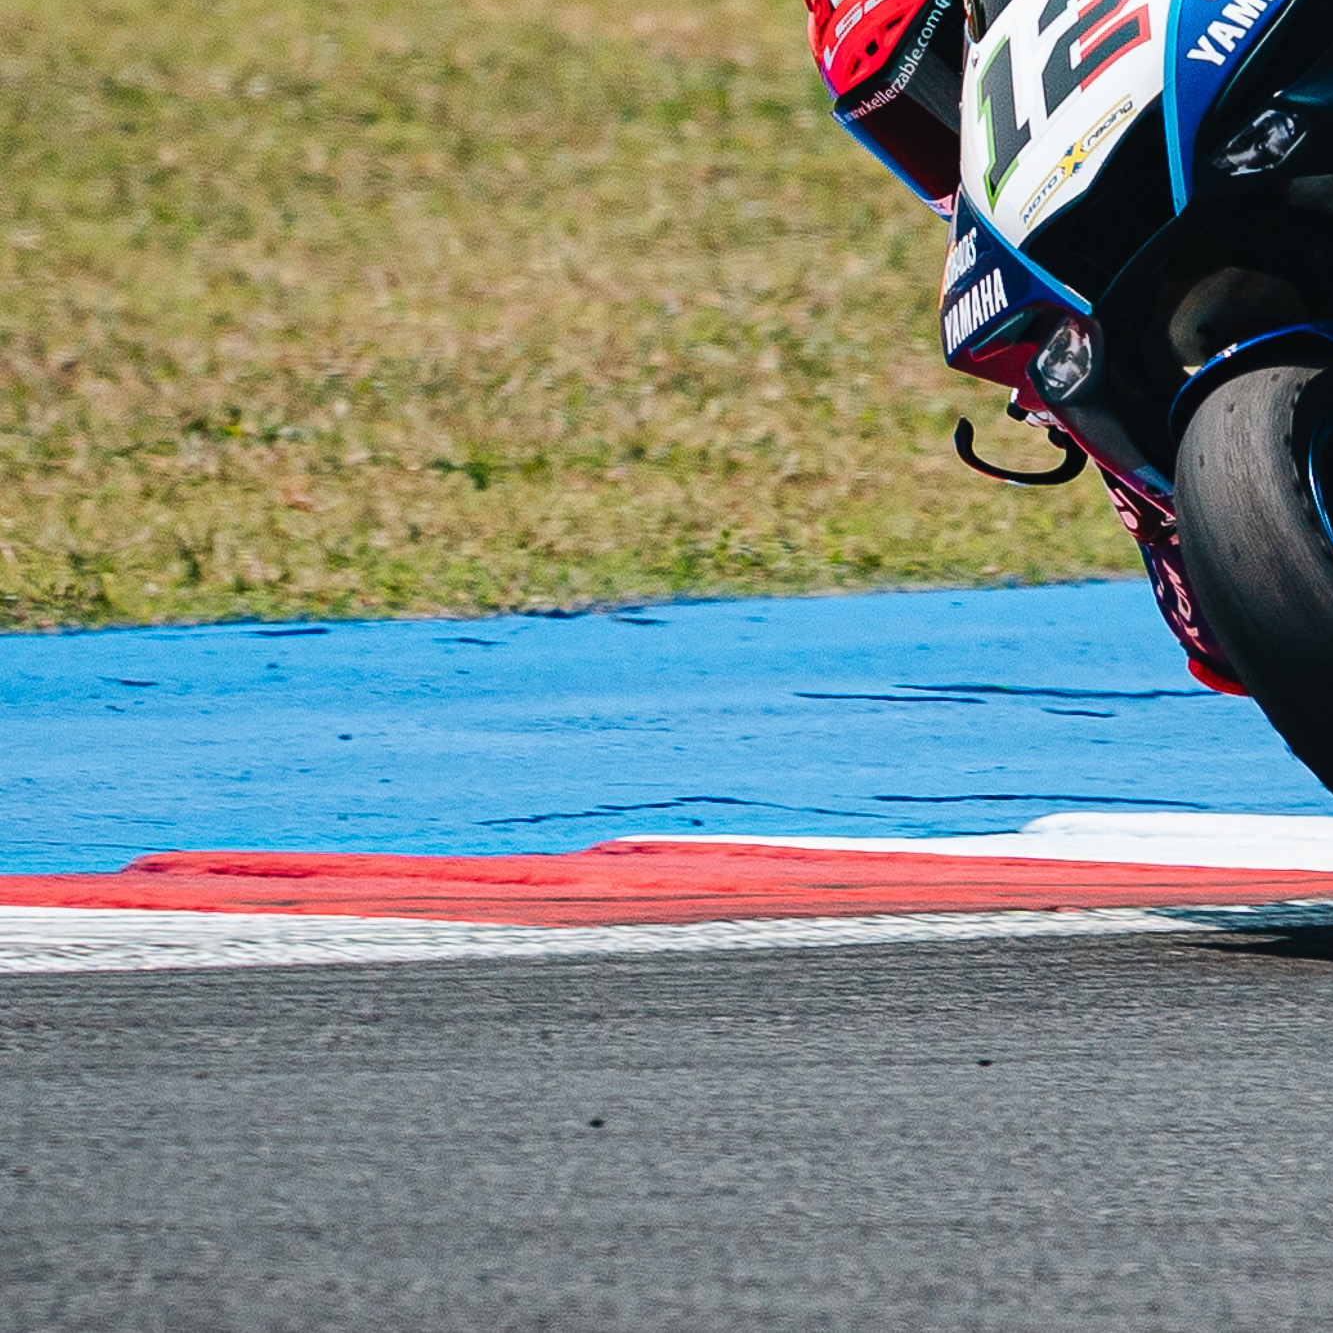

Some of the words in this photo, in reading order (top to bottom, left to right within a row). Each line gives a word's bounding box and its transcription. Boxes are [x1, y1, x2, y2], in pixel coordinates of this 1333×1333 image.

[1021, 175, 1059, 225] MOTO
[1086, 98, 1134, 148] racing
[945, 267, 1008, 356] YAMAHA
